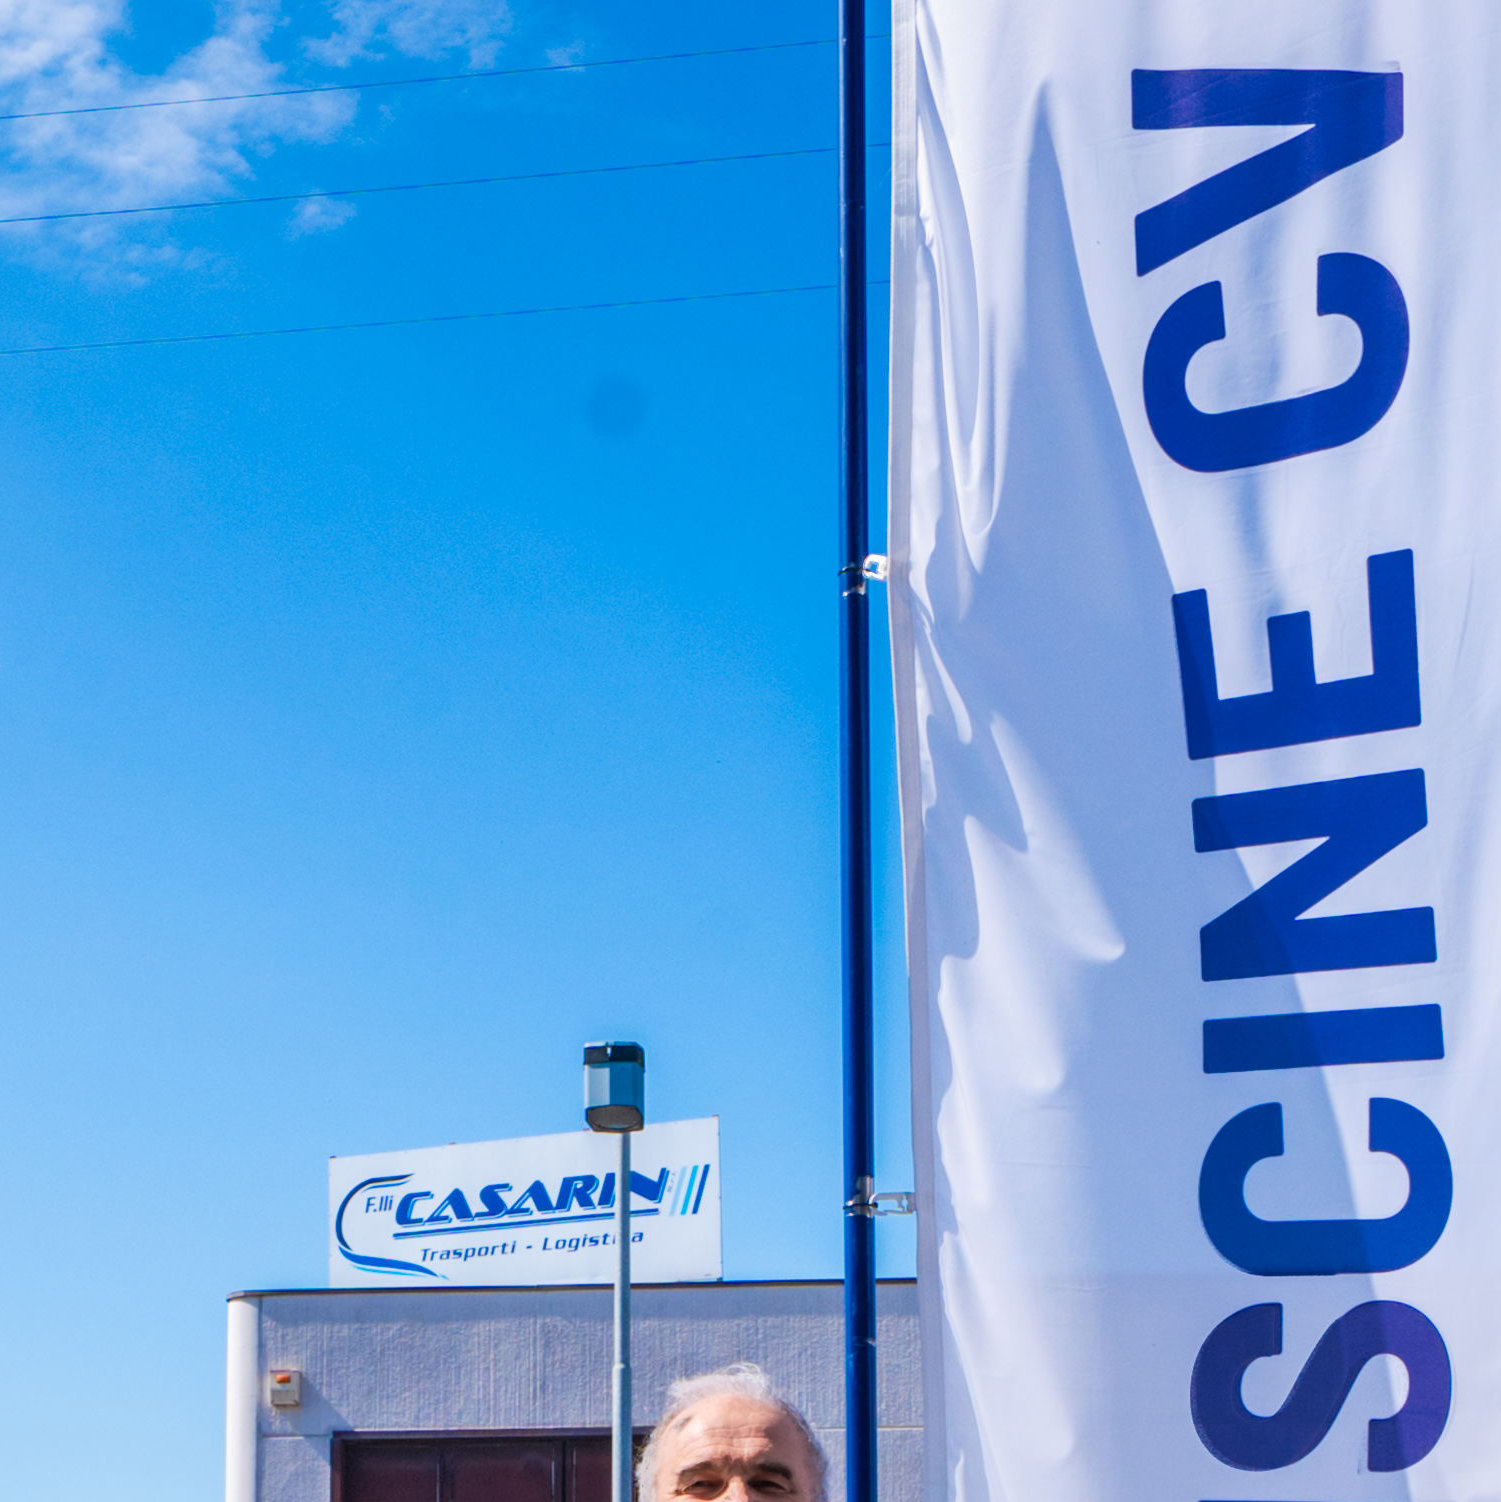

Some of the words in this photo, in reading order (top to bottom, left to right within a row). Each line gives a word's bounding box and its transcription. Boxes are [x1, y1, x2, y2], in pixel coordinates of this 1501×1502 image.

[1131, 67, 1410, 473] CV
[365, 1195, 394, 1214] F.lli
[395, 1167, 670, 1228] CASARIN
[421, 1241, 517, 1262] Trasporti
[542, 1231, 644, 1252] Logistia
